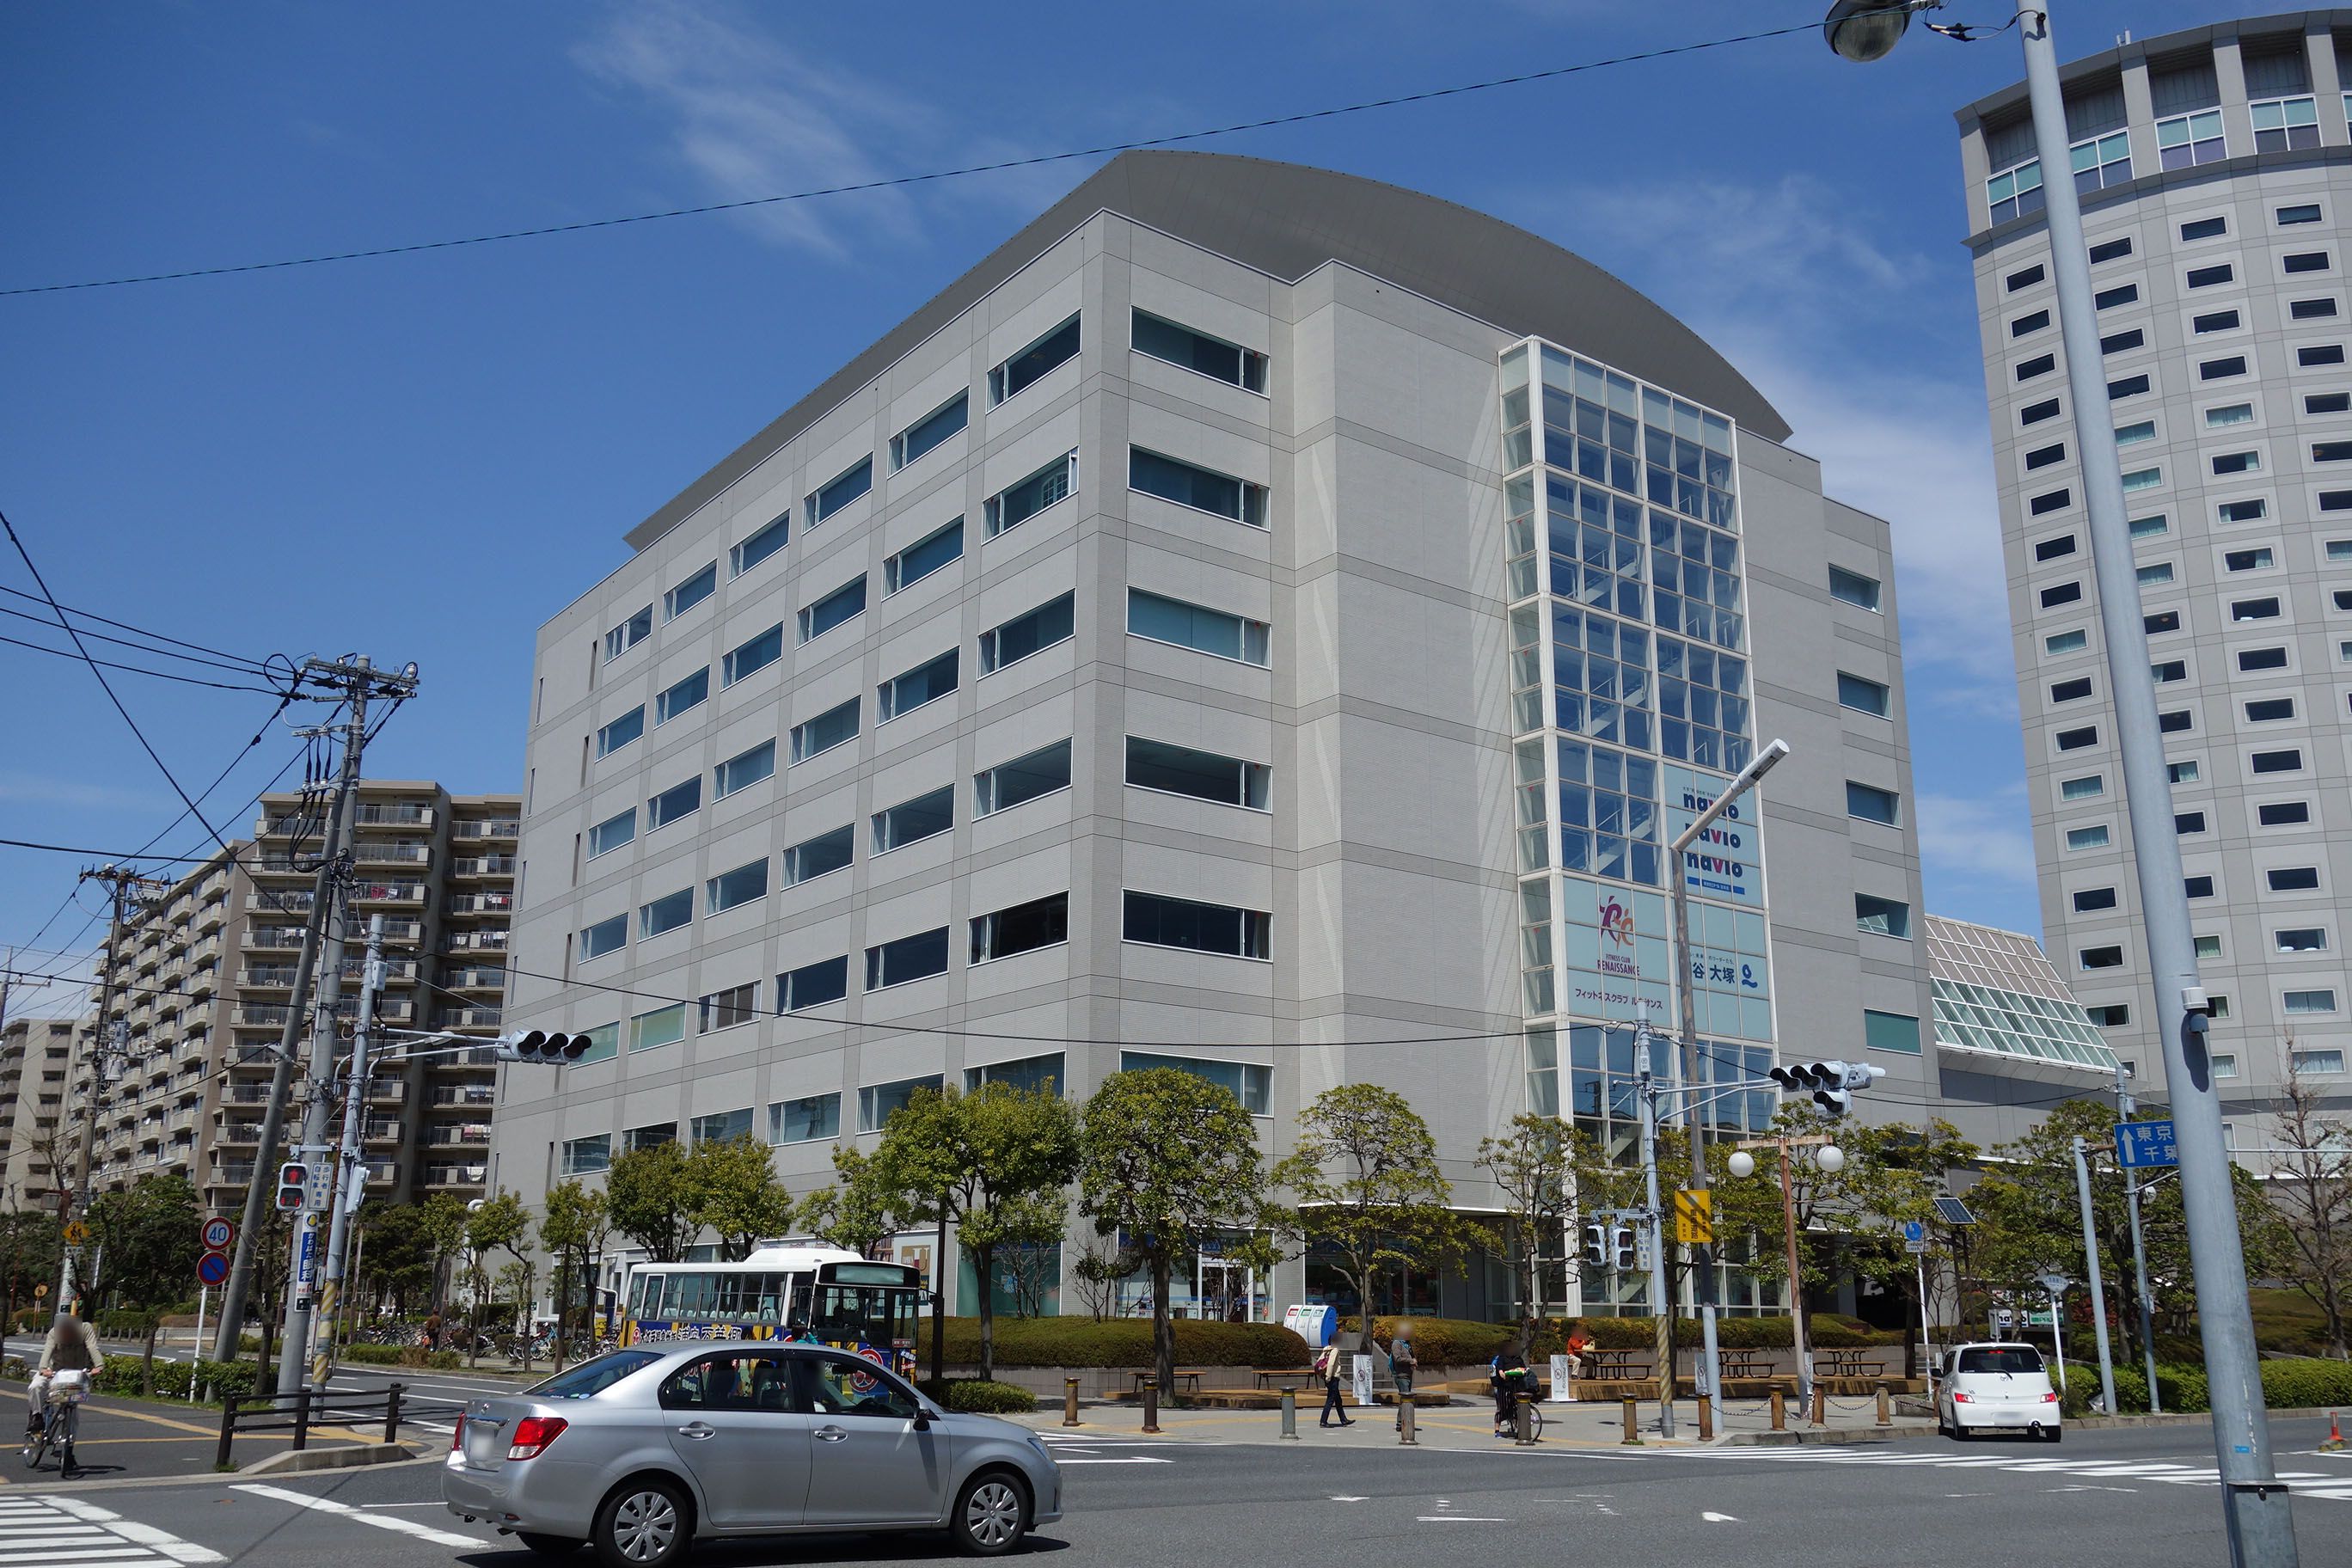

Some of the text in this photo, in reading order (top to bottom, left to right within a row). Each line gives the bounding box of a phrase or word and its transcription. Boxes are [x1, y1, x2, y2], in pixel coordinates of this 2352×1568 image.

[1683, 793, 1739, 819] nao
[1685, 823, 1741, 848] avio
[1687, 852, 1743, 878] navio
[1606, 953, 1620, 962] FITNESS
[1596, 959, 1640, 976] RENAISSANCE
[1692, 962, 1736, 984] 谷大塚
[1575, 988, 1663, 1009] フィットネスクラブ ルサンス
[2135, 1125, 2173, 1142] 東京
[2144, 1144, 2178, 1162] 千葉
[208, 1226, 227, 1241] 40
